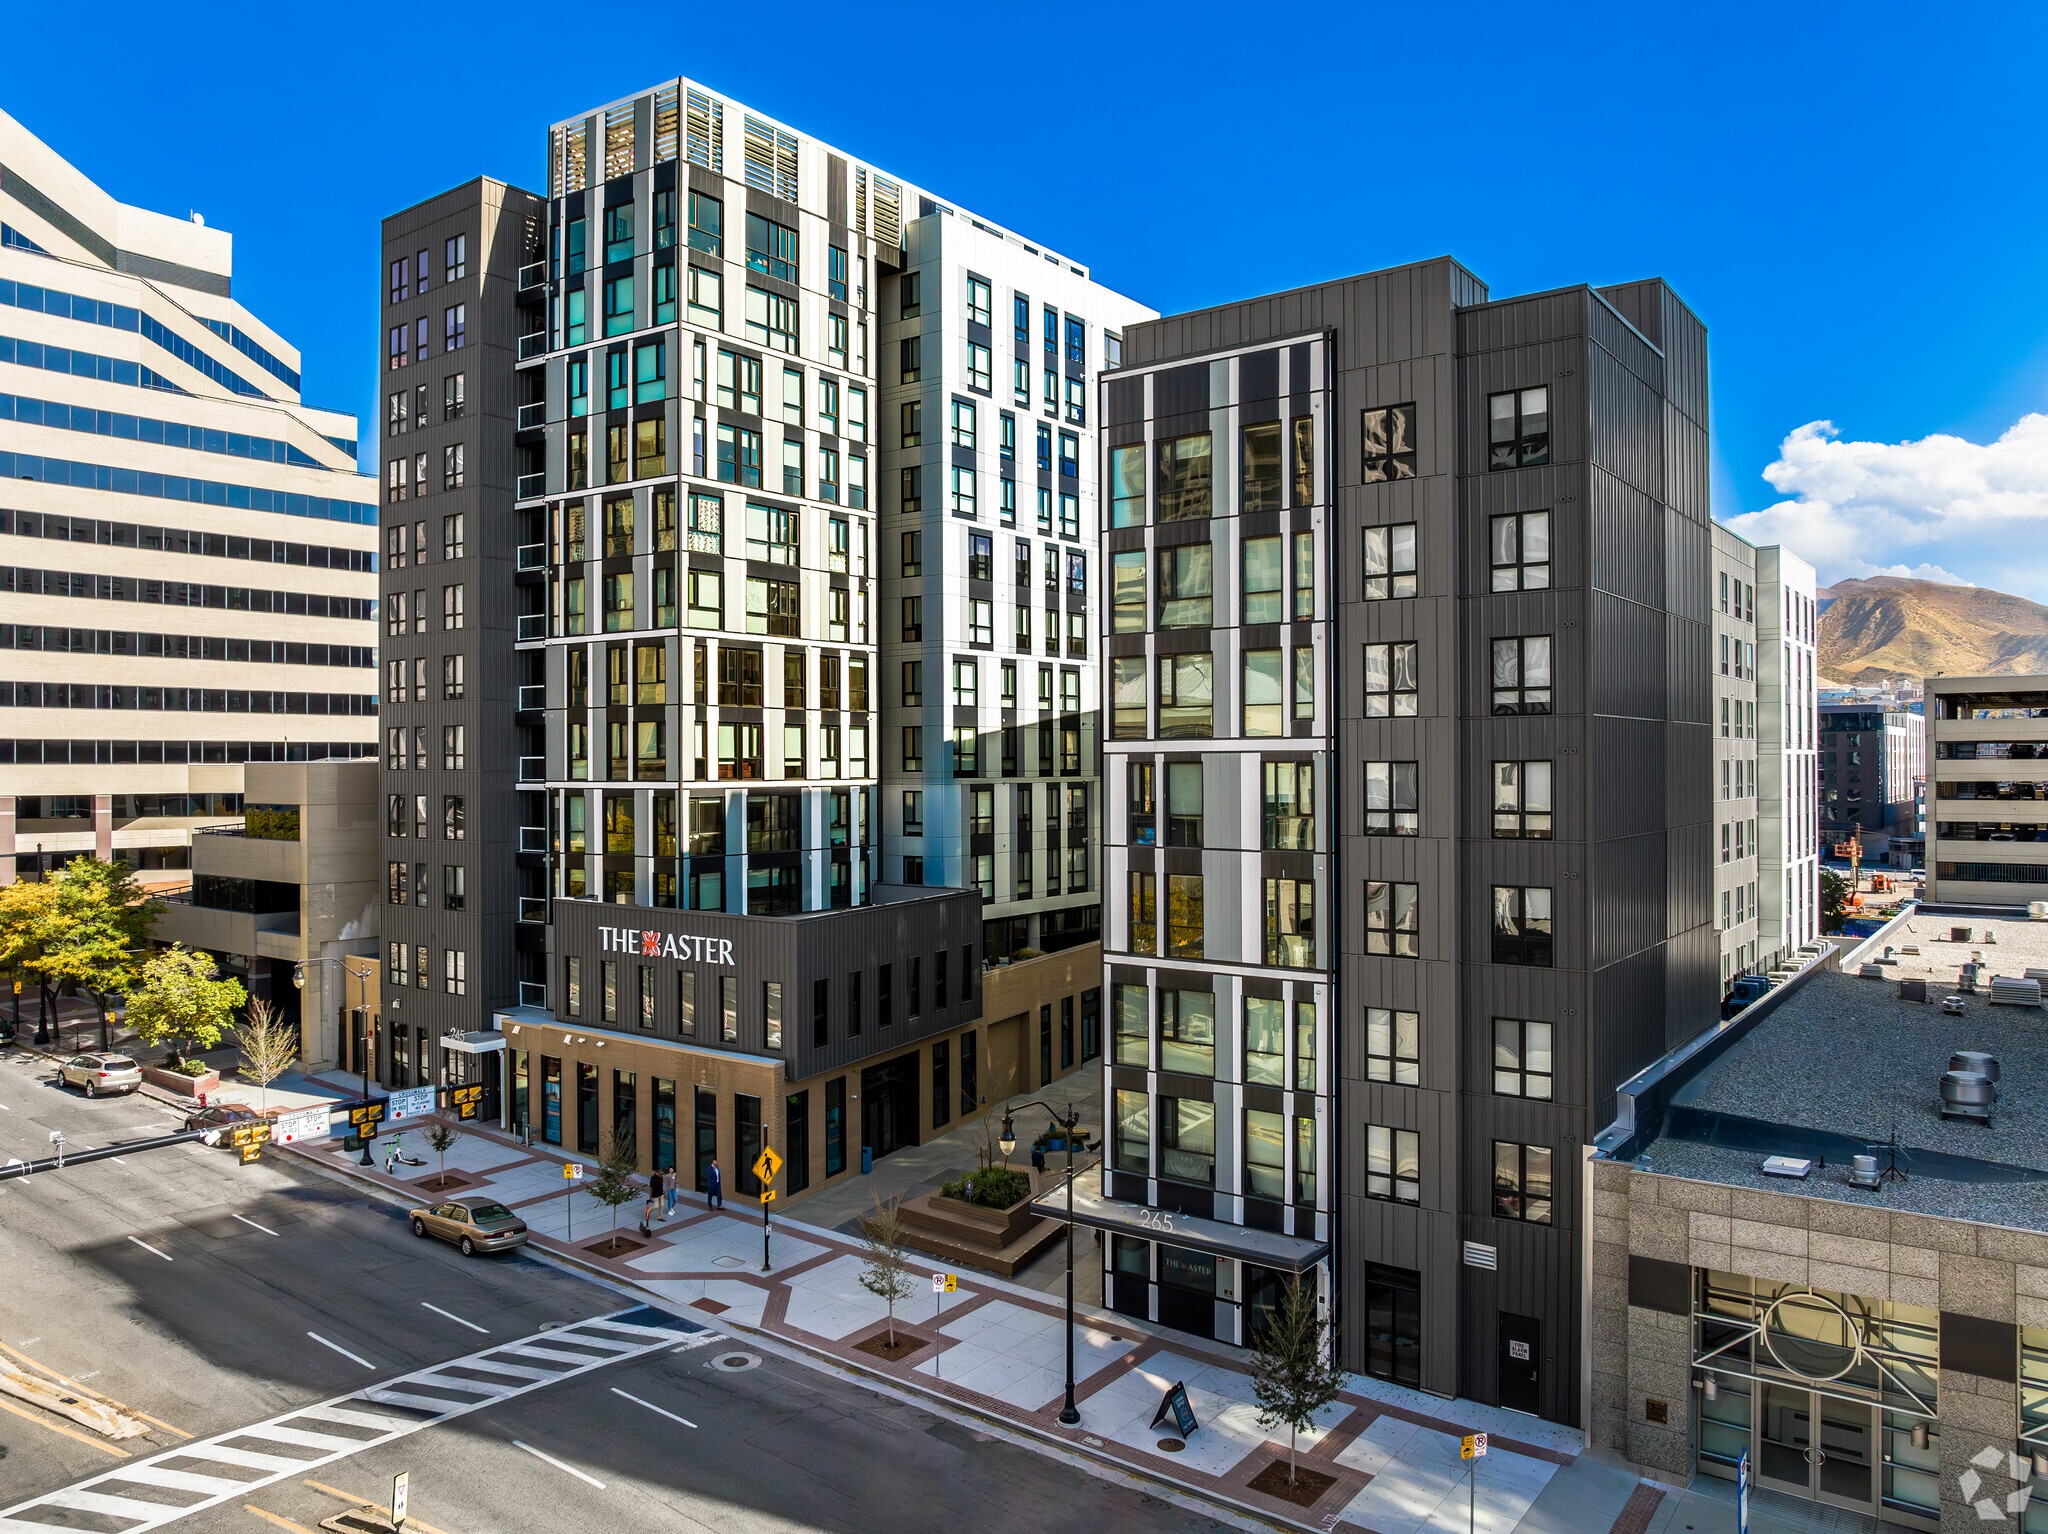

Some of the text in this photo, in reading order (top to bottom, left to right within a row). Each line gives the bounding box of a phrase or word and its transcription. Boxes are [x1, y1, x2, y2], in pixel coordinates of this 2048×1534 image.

[598, 926, 735, 966] THE ASTER
[450, 1027, 465, 1042] 245
[280, 1121, 296, 1129] STOP
[306, 1114, 322, 1123] STOP
[1140, 1209, 1173, 1233] 265
[1166, 1258, 1212, 1275] THE ASTER
